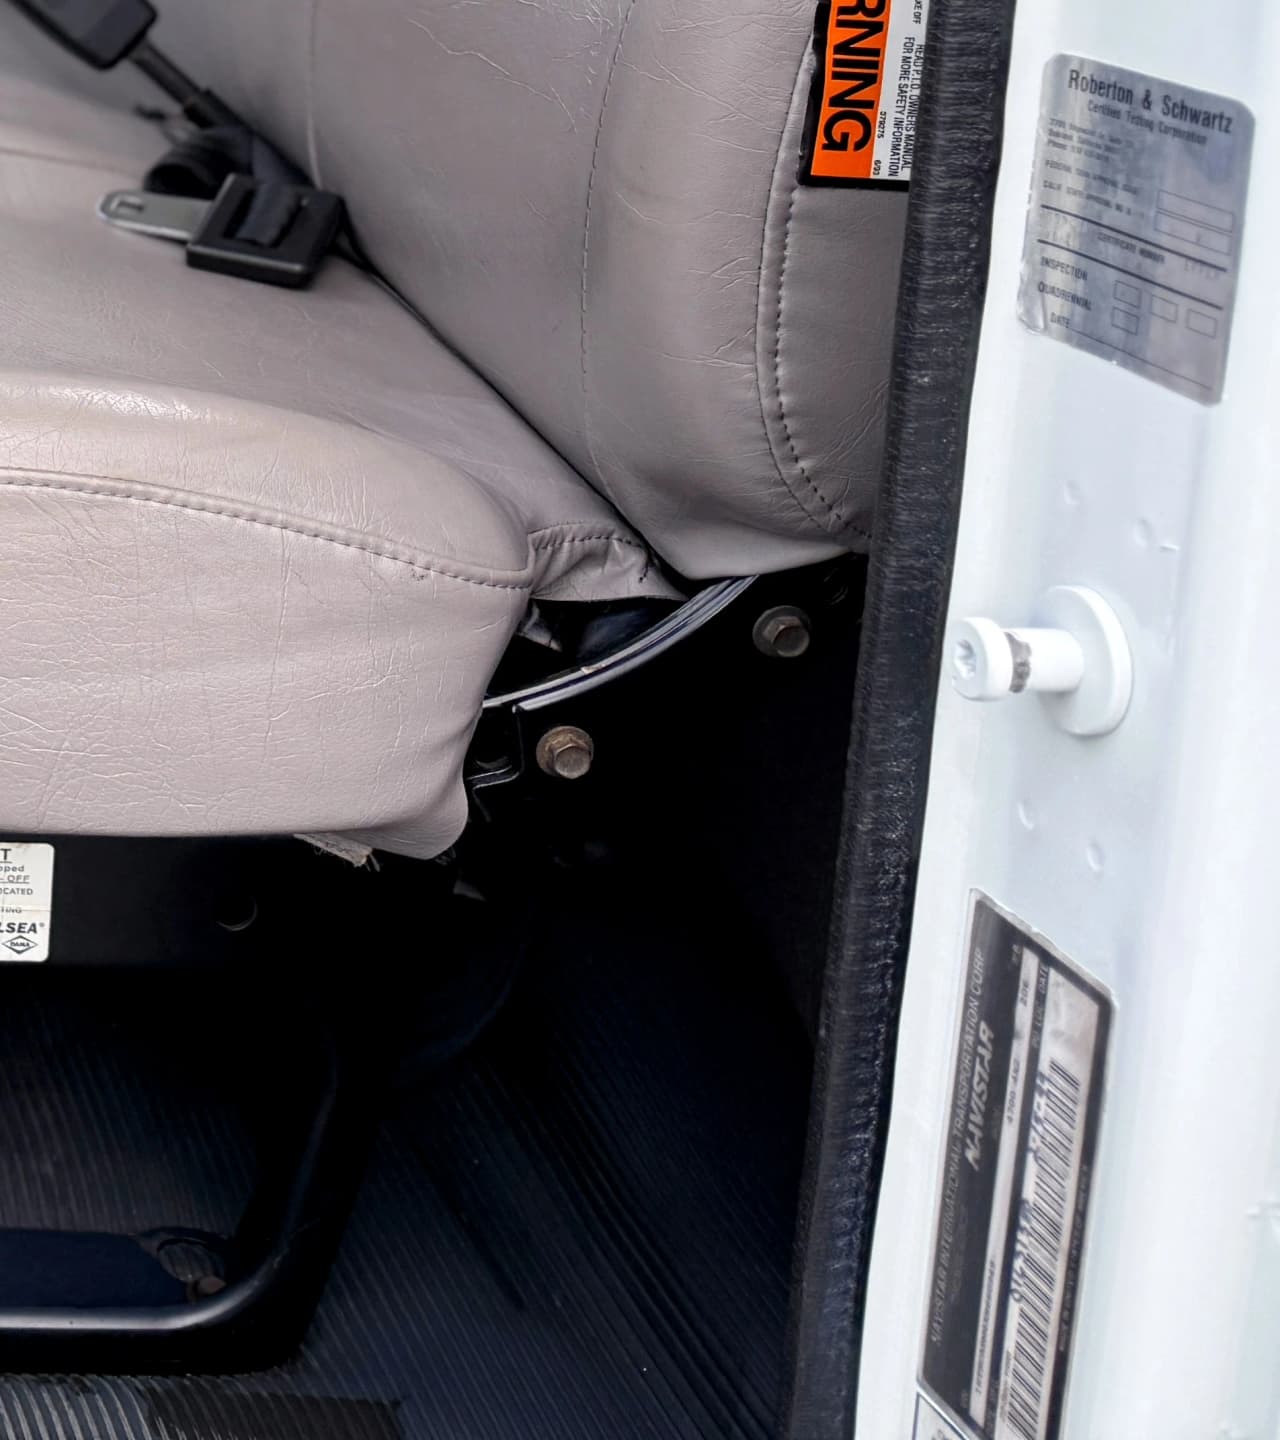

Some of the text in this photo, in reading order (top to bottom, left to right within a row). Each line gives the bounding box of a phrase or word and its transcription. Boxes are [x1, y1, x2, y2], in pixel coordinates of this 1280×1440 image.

[913, 12, 921, 24] OFF
[888, 37, 915, 177] FOR MORE SAFETY INFORMATION
[905, 94, 920, 132] OWNERS
[1068, 69, 1234, 134] Roberton & Schwartz
[901, 134, 915, 171] MANUAL
[1040, 256, 1088, 281] INSPECTION
[1050, 312, 1071, 329] DATE
[7, 875, 30, 883] OFF
[955, 997, 981, 1139] TRANSPORTATION
[964, 1024, 995, 1171] NAVISTAR
